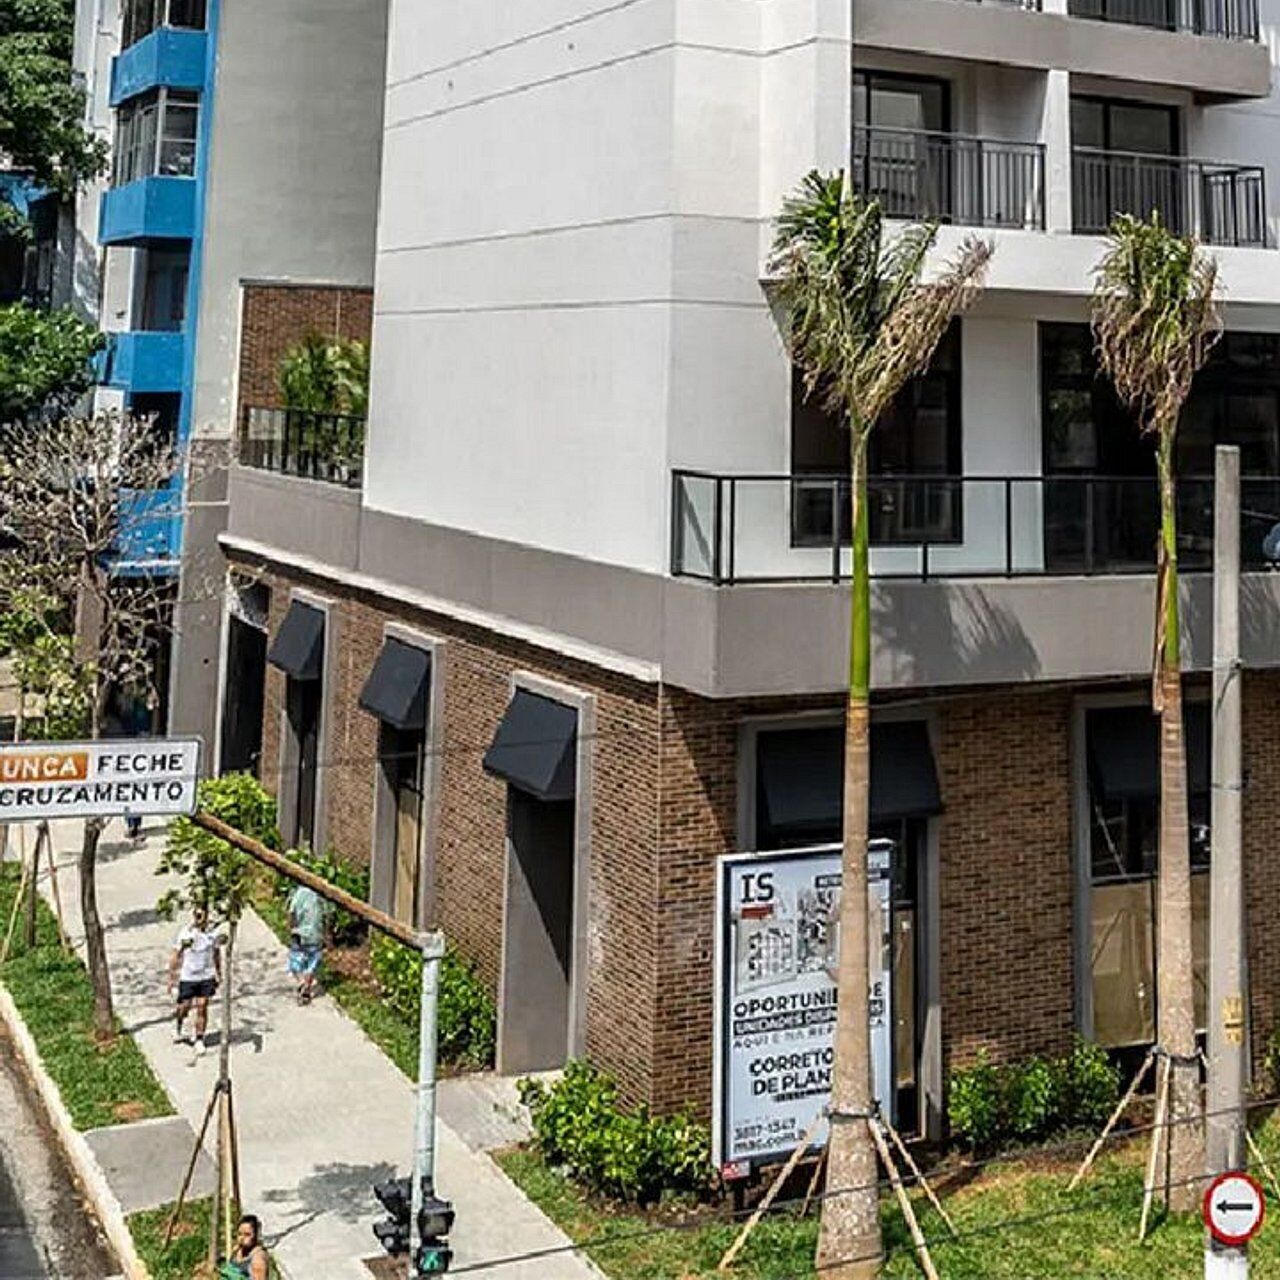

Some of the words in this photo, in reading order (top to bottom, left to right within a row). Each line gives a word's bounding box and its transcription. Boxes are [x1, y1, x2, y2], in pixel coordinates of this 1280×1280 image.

[3, 757, 77, 778] UNCA
[97, 754, 183, 772] FECHE
[0, 781, 183, 806] CRUZAMENTO
[741, 873, 774, 903] IS
[749, 1047, 833, 1077] CORRETO
[753, 1078, 778, 1096] DE
